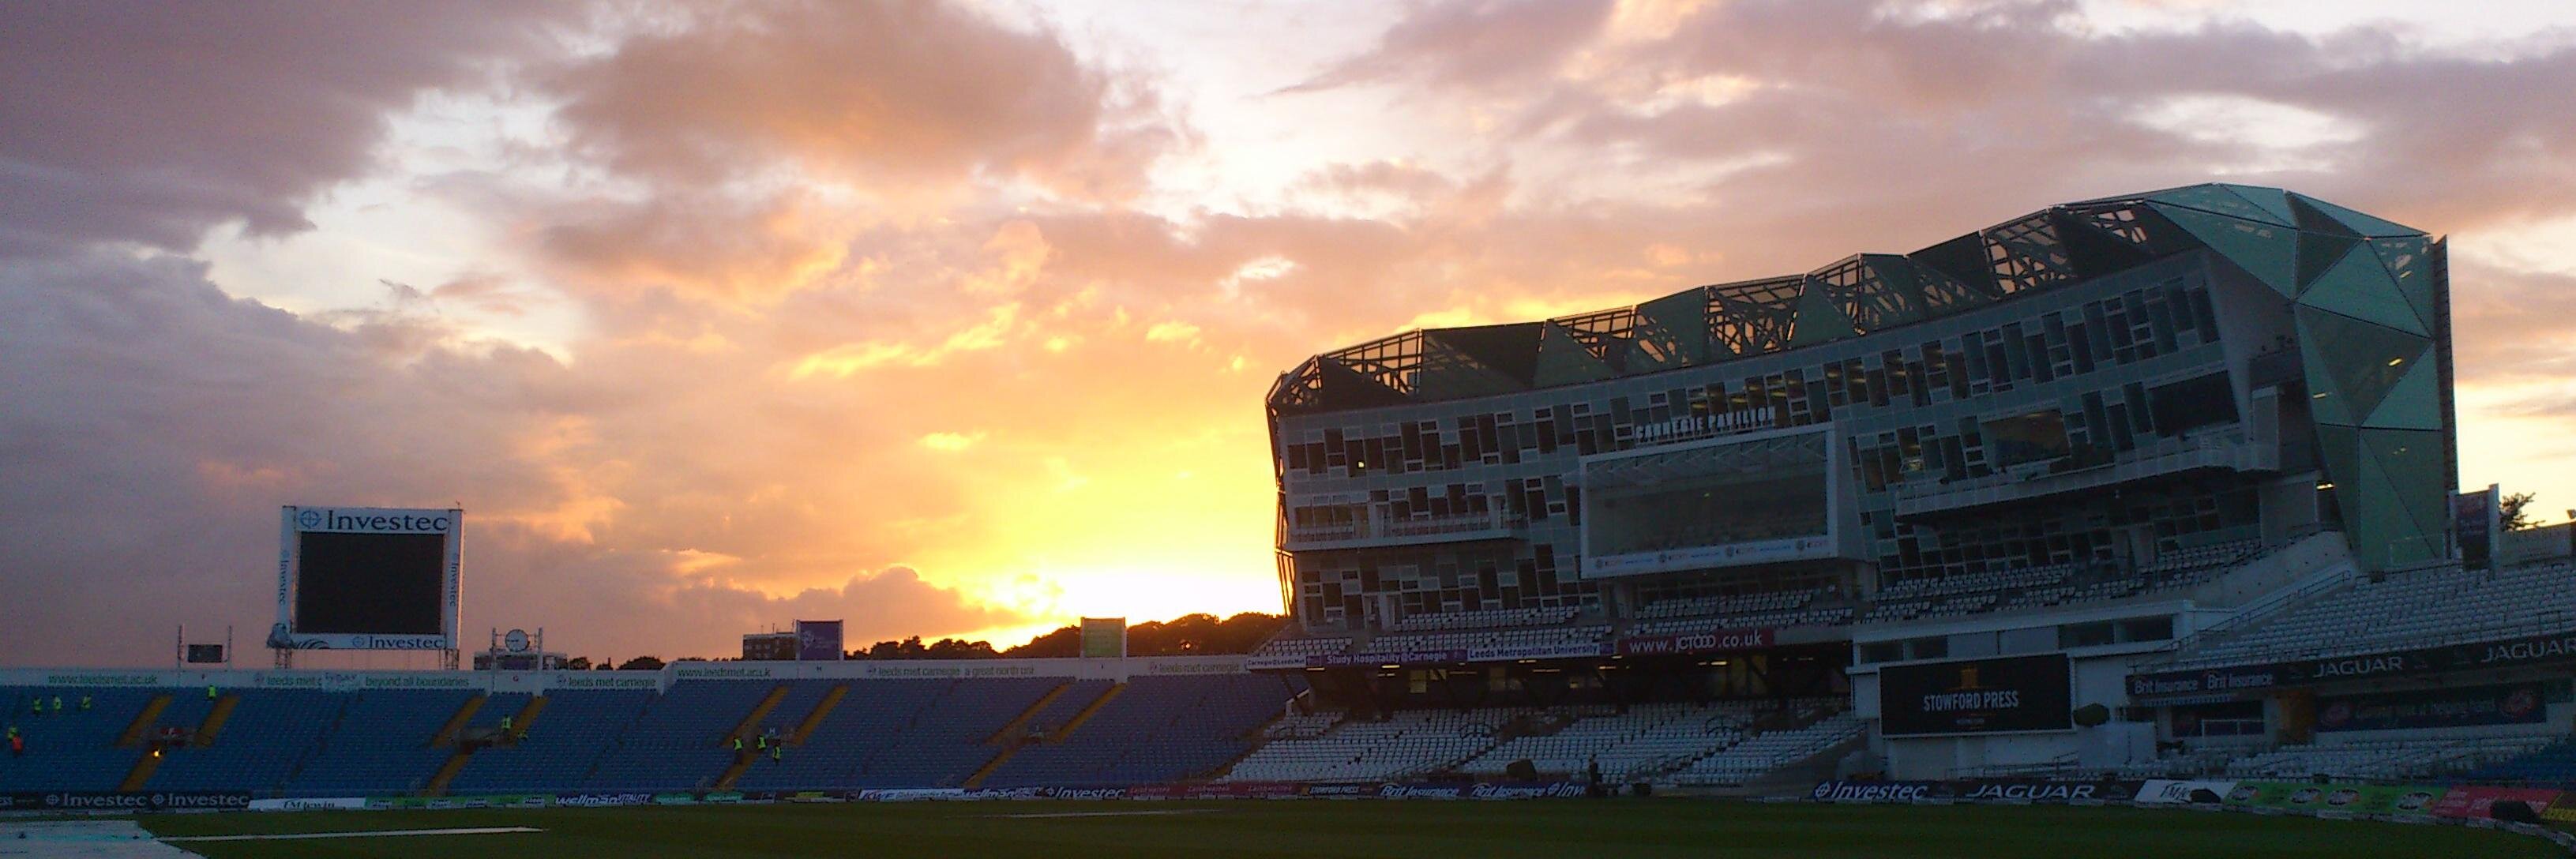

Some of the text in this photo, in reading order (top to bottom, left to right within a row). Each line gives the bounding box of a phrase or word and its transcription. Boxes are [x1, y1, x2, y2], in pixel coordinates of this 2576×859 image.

[1636, 406, 1775, 439] CARNEGIE PAVILION
[328, 510, 448, 531] Investec
[279, 560, 290, 605] Investec
[449, 563, 460, 607] Investec
[369, 636, 445, 649] Investec
[1470, 642, 1598, 658] Leeds Metropolitan University
[2480, 637, 2576, 662] JAGUAR
[1327, 653, 1351, 666] Study
[2313, 656, 2403, 677] JAGUAR
[2157, 678, 2199, 693] Insurance
[2229, 672, 2274, 688] Insurance
[1924, 689, 2019, 711] STOWFORD PRESS
[1056, 786, 1126, 799] Investec
[1831, 781, 1928, 800] Investec
[1966, 785, 2096, 798] JAGUAR
[64, 792, 148, 807] Investec
[167, 792, 250, 807] Investec
[556, 793, 619, 805] wellman
